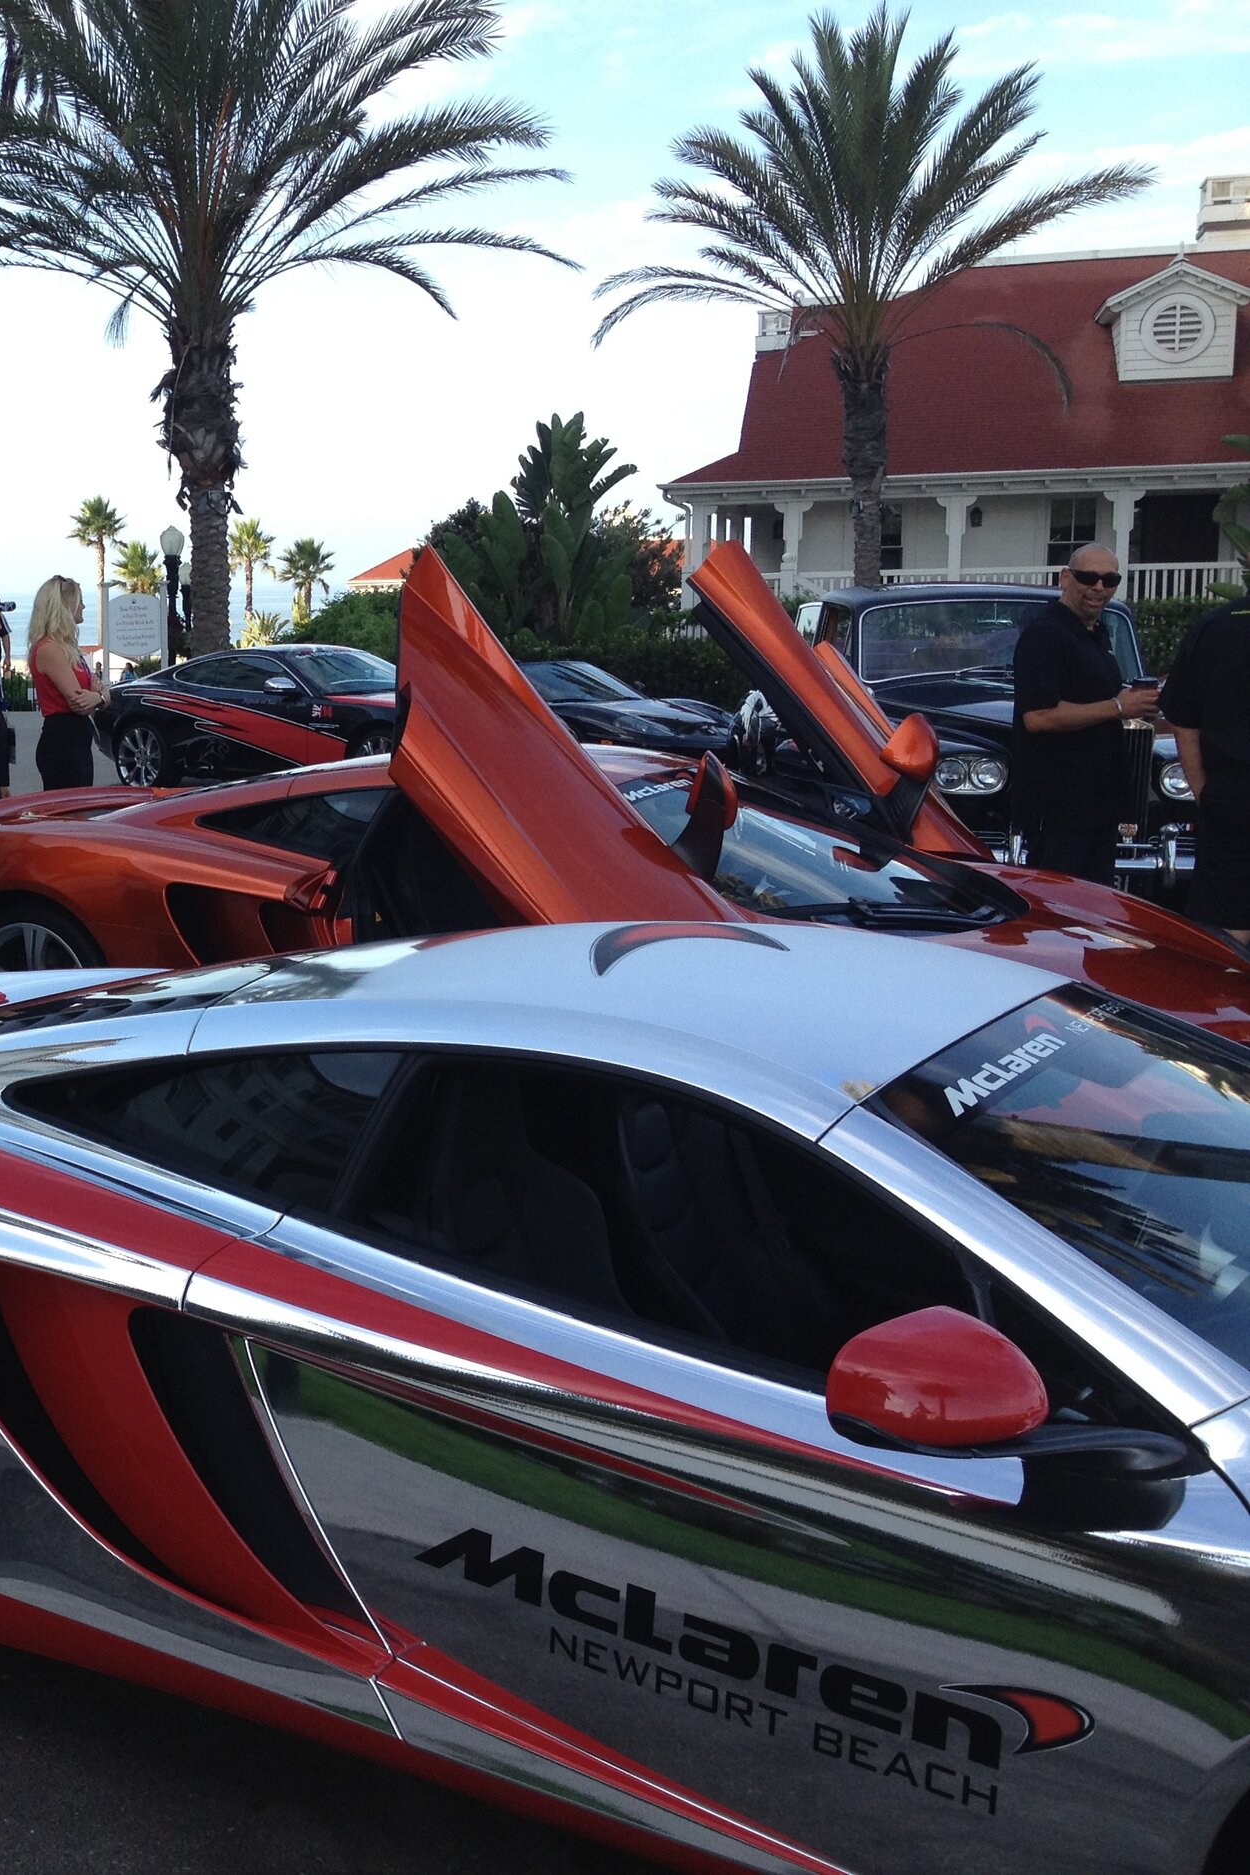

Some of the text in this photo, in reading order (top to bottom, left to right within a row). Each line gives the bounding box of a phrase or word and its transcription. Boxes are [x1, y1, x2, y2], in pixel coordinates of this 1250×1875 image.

[943, 1033, 1067, 1117] McLaren
[413, 1527, 1002, 1770] McLaren
[549, 1627, 999, 1815] NEWPORT BEACH
